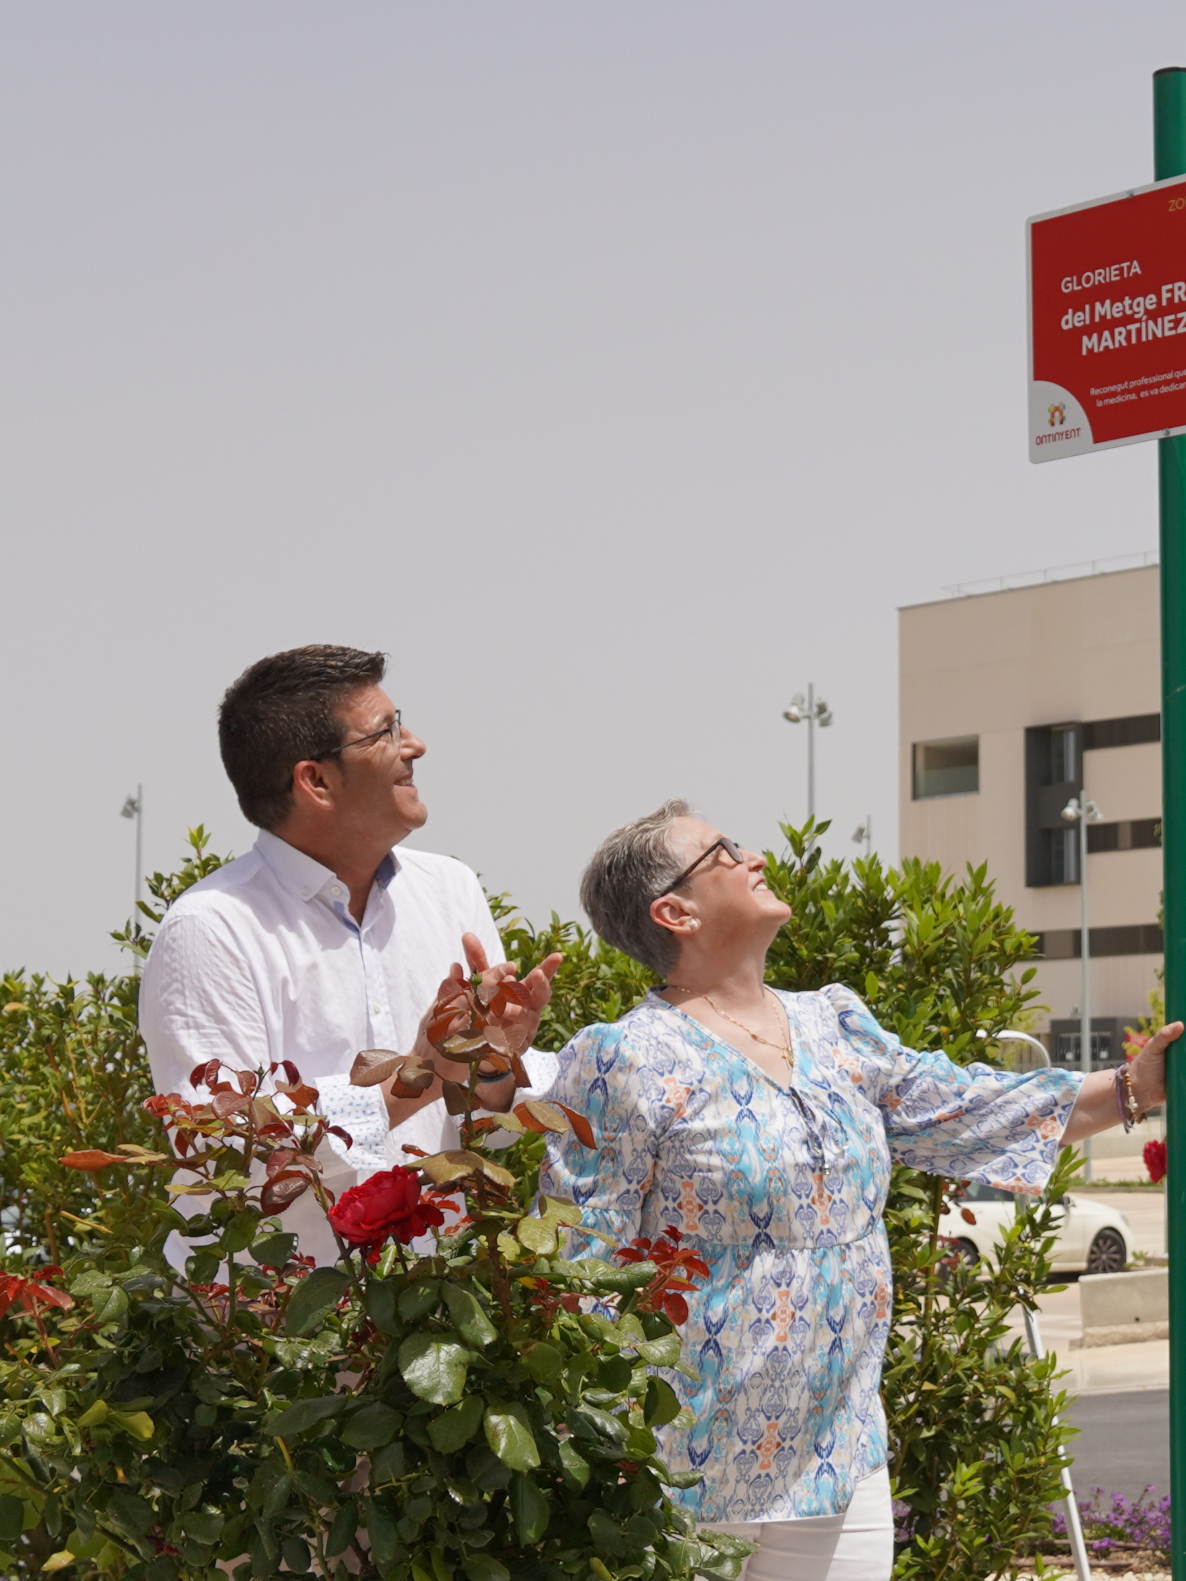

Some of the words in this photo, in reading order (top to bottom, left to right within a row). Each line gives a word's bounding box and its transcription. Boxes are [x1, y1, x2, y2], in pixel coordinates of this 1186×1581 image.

[1061, 260, 1142, 293] GLORIETA
[1061, 304, 1090, 330] del
[1095, 294, 1157, 322] Metge
[1090, 381, 1128, 396] Reconegut
[1129, 370, 1174, 389] professional
[1096, 399, 1103, 407] la
[1140, 390, 1149, 398] es
[1150, 387, 1158, 396] va
[1159, 380, 1186, 394] dedicar
